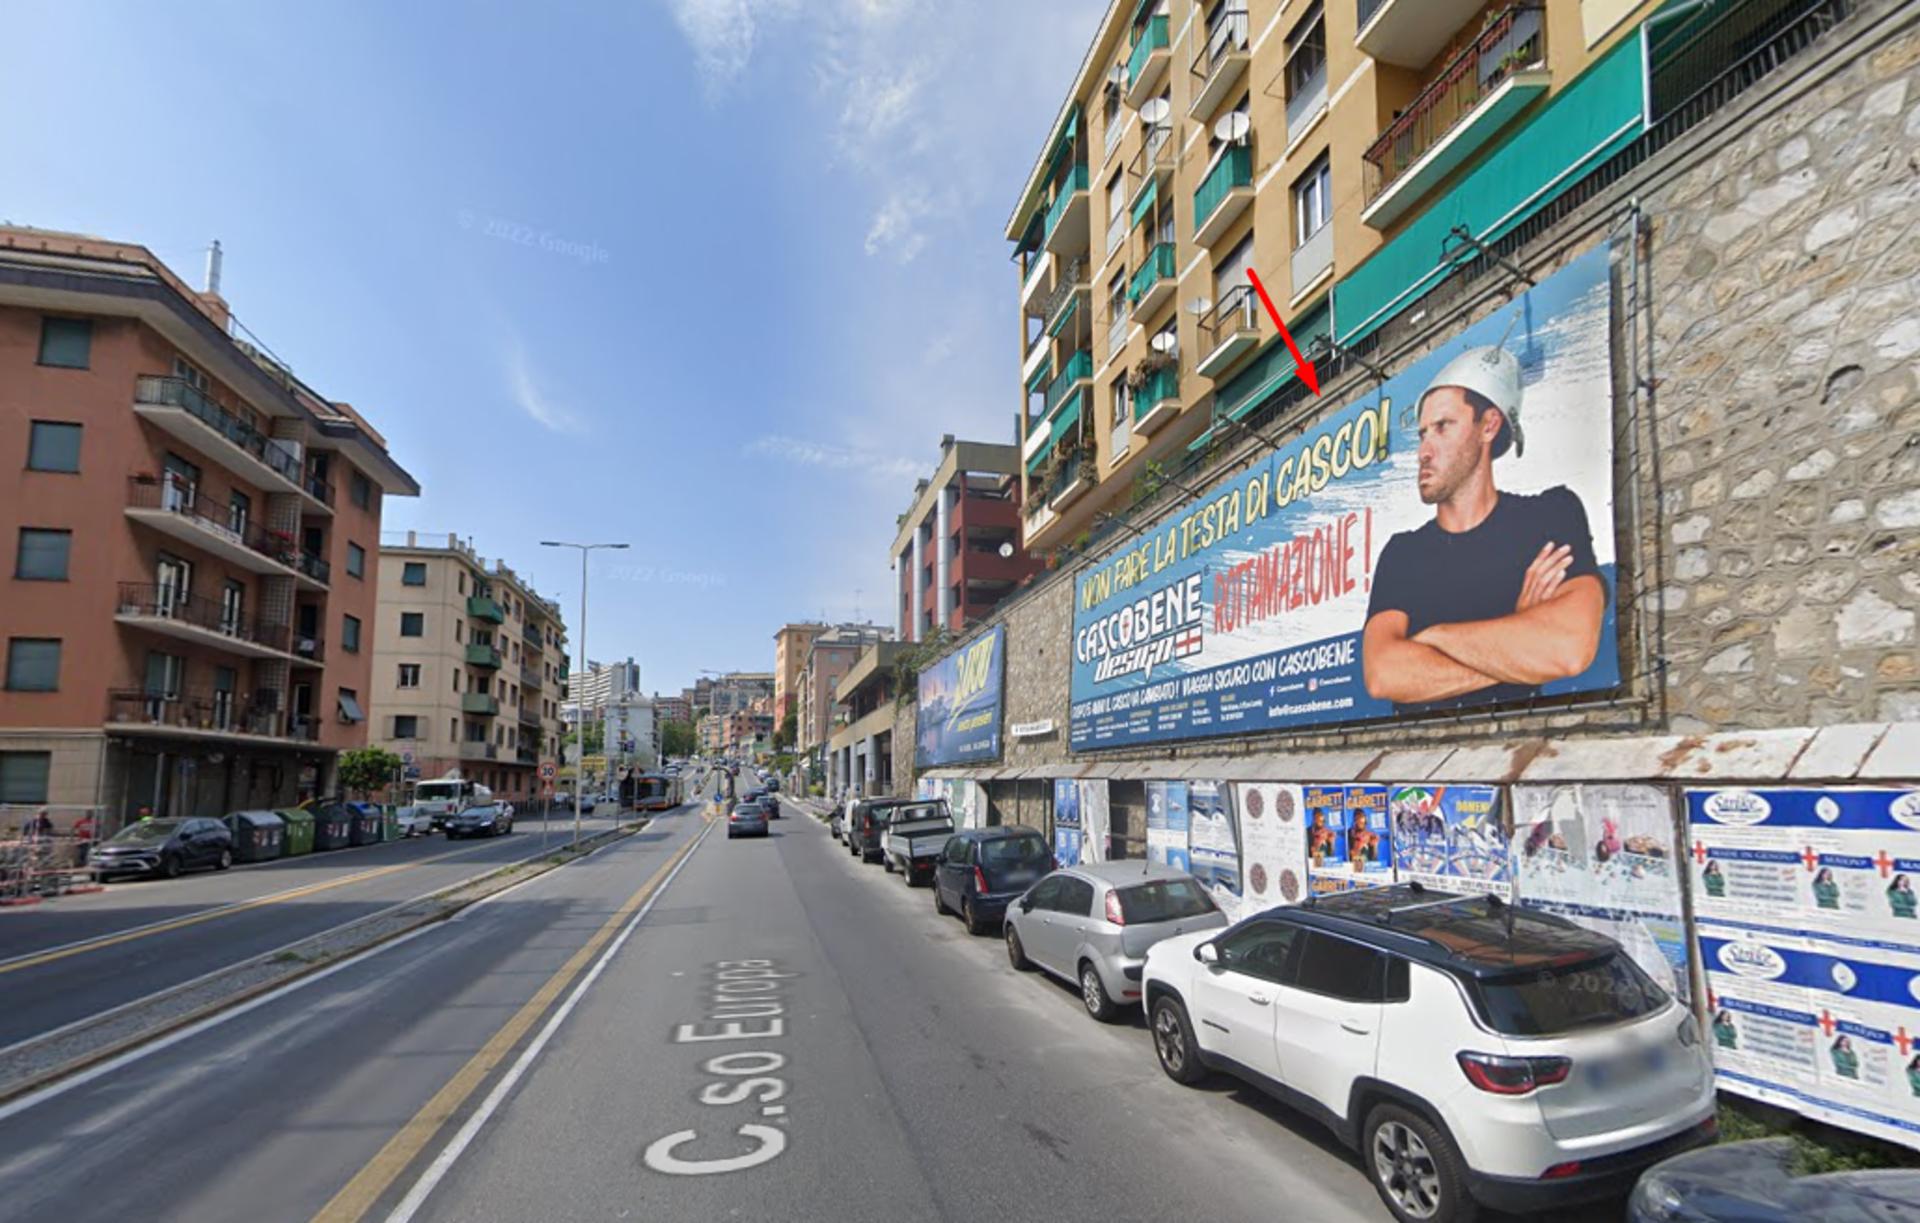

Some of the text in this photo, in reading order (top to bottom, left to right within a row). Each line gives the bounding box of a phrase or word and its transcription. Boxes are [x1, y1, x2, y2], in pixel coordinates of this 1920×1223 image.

[1081, 398, 1391, 611] NON FARE LA TESTA DI CASCO!
[1077, 572, 1202, 664] CASCOBENE
[1093, 635, 1175, 684] design
[1214, 664, 1251, 692] SICURO
[1252, 656, 1276, 683] CON
[1278, 639, 1358, 677] CASCOBENE
